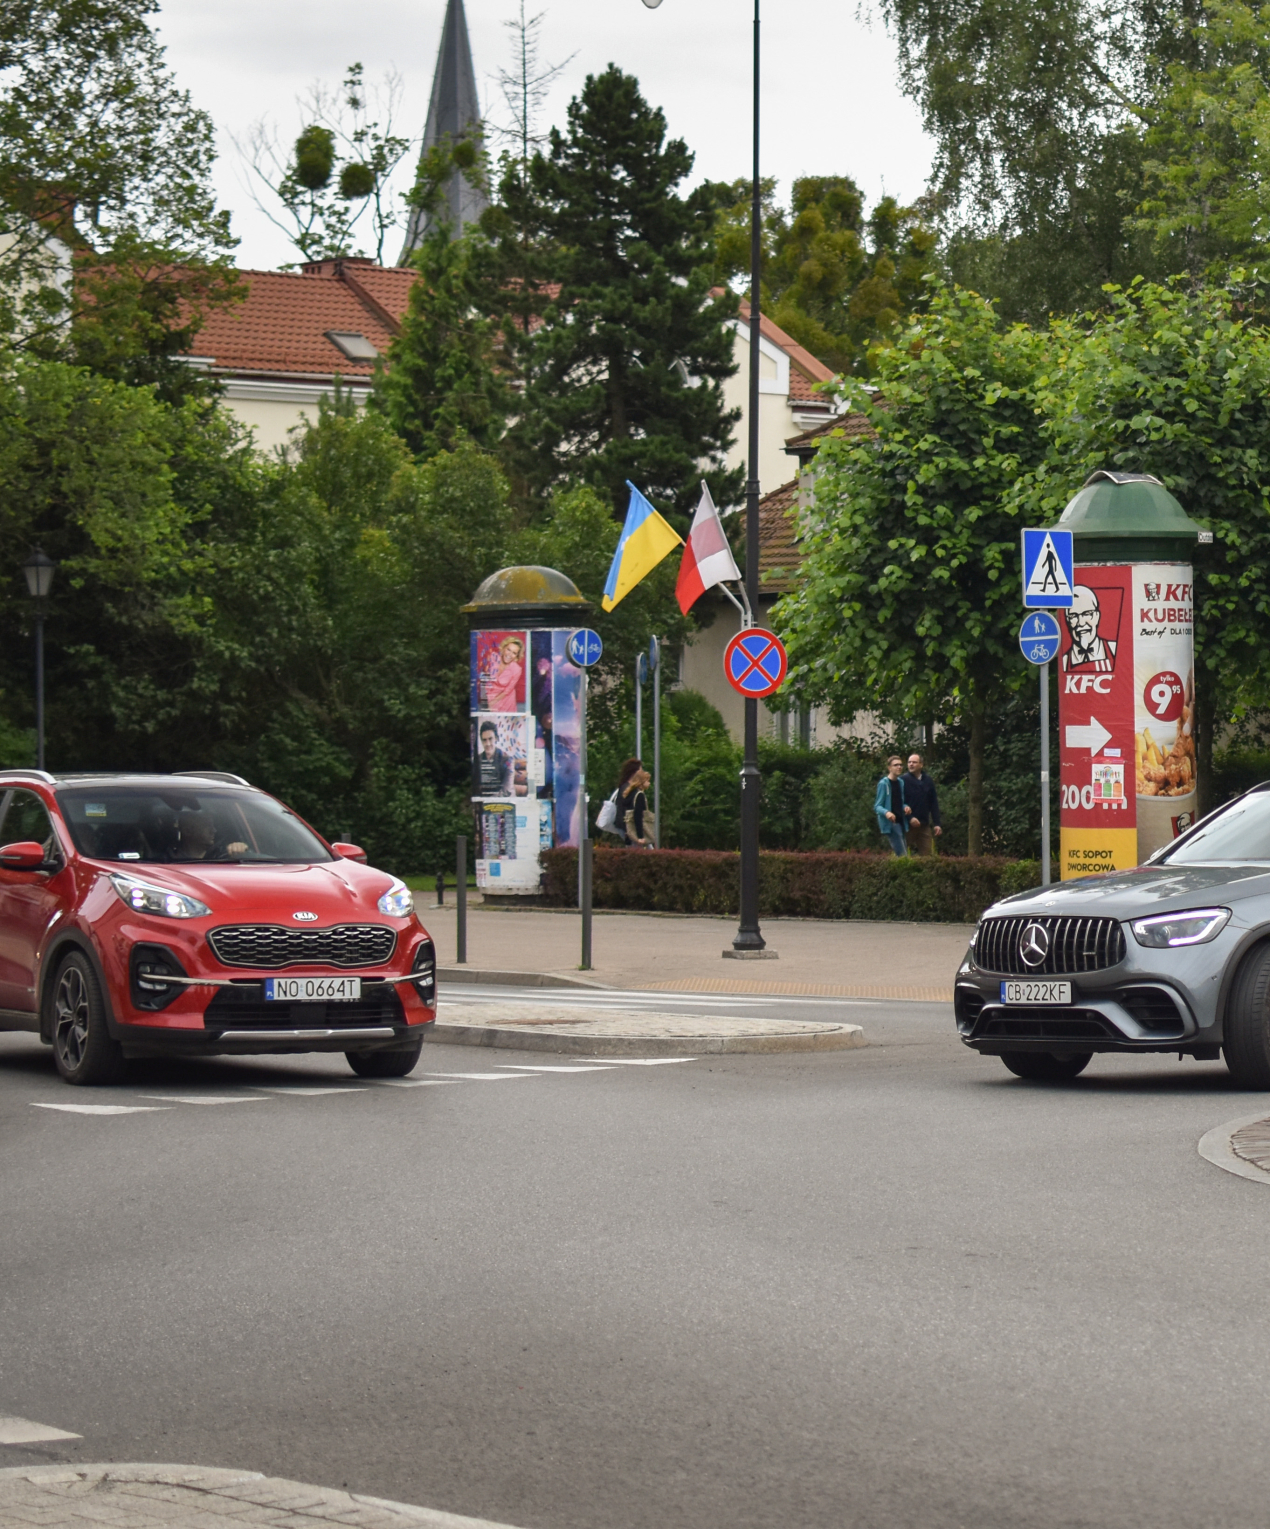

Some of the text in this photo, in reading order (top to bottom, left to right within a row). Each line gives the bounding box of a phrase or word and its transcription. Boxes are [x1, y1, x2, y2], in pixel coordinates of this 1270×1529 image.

[1140, 627, 1158, 636] Best
[1157, 626, 1167, 639] of
[1064, 674, 1113, 694] KFC
[1160, 674, 1175, 684] tylko
[1150, 683, 1173, 715] 9
[1062, 784, 1096, 810] 200
[1068, 850, 1114, 859] KFC SOPOT
[1067, 862, 1116, 872] DWORCOWA
[277, 979, 356, 997] NO 0664T
[1007, 983, 1067, 1001] CB 222KF
